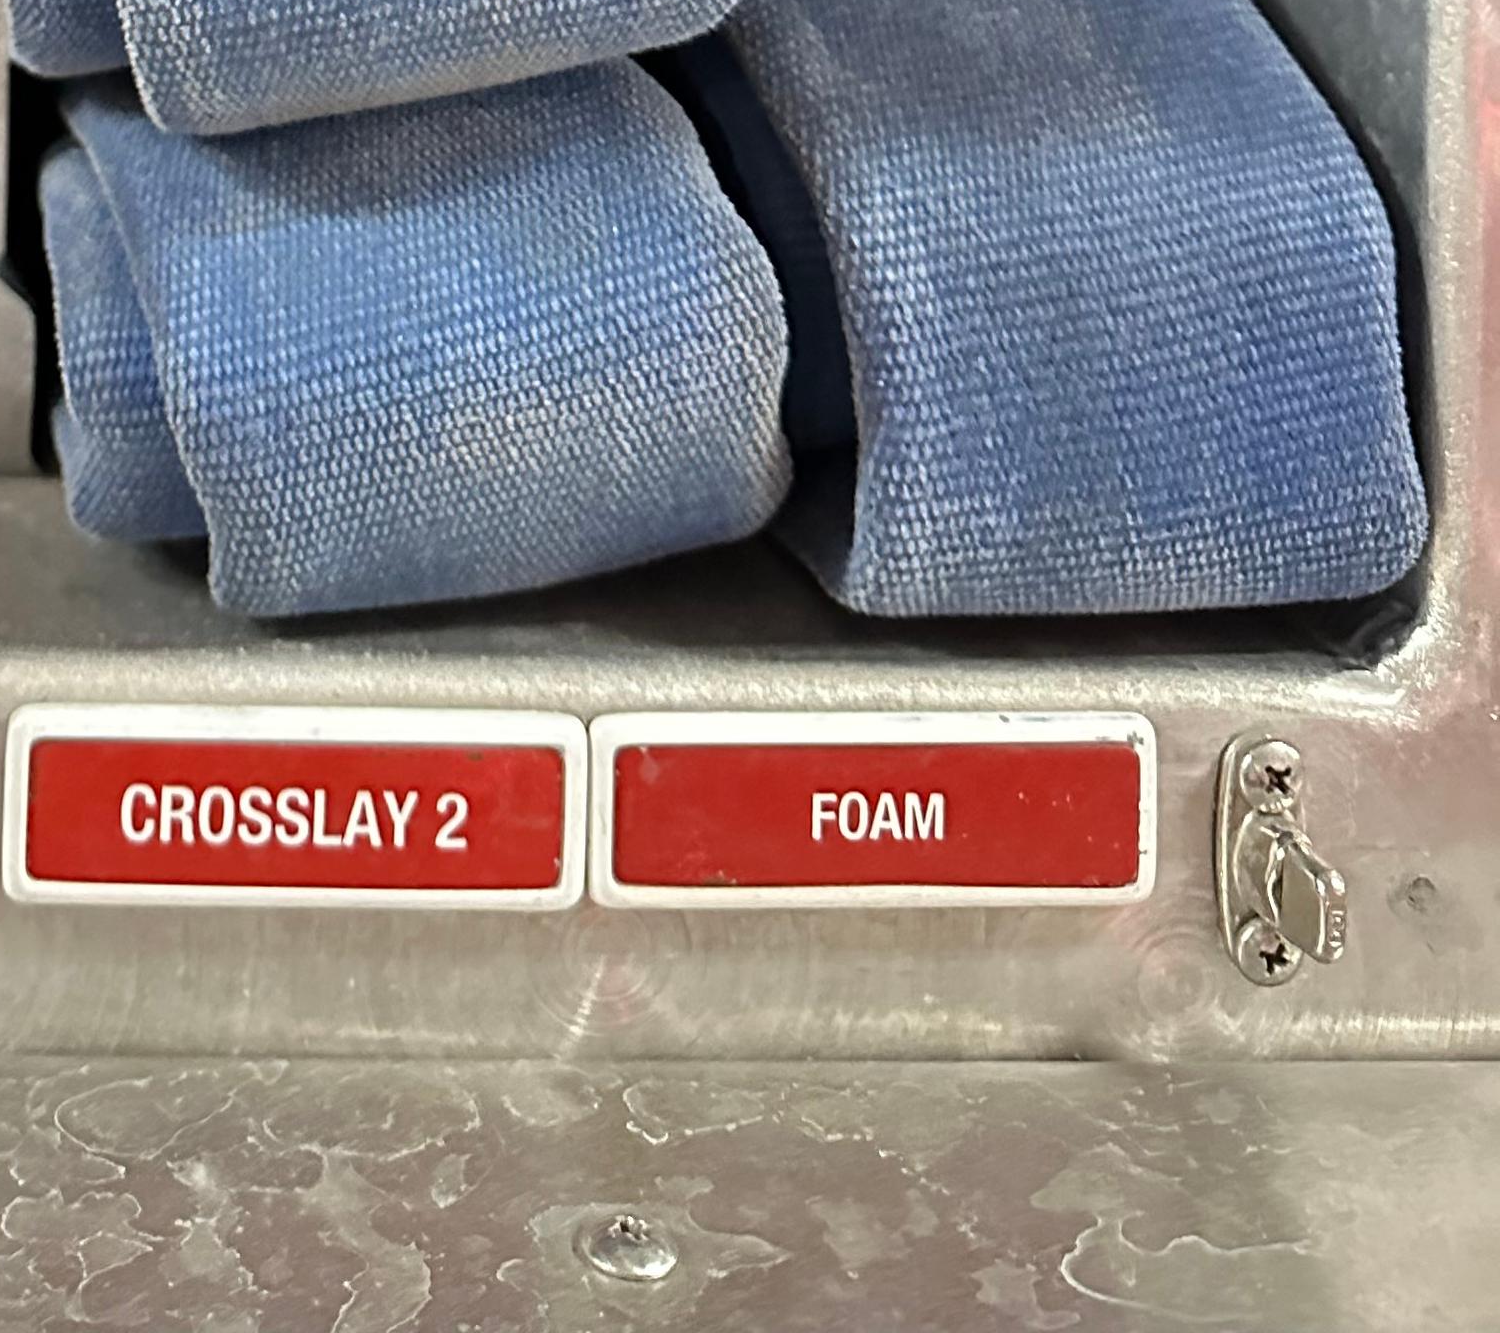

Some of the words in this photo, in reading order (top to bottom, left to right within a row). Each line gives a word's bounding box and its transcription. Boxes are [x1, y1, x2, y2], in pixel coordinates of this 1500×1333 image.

[119, 782, 420, 850] CROSSLAY
[433, 791, 470, 851] 2
[810, 790, 946, 843] FOAM
